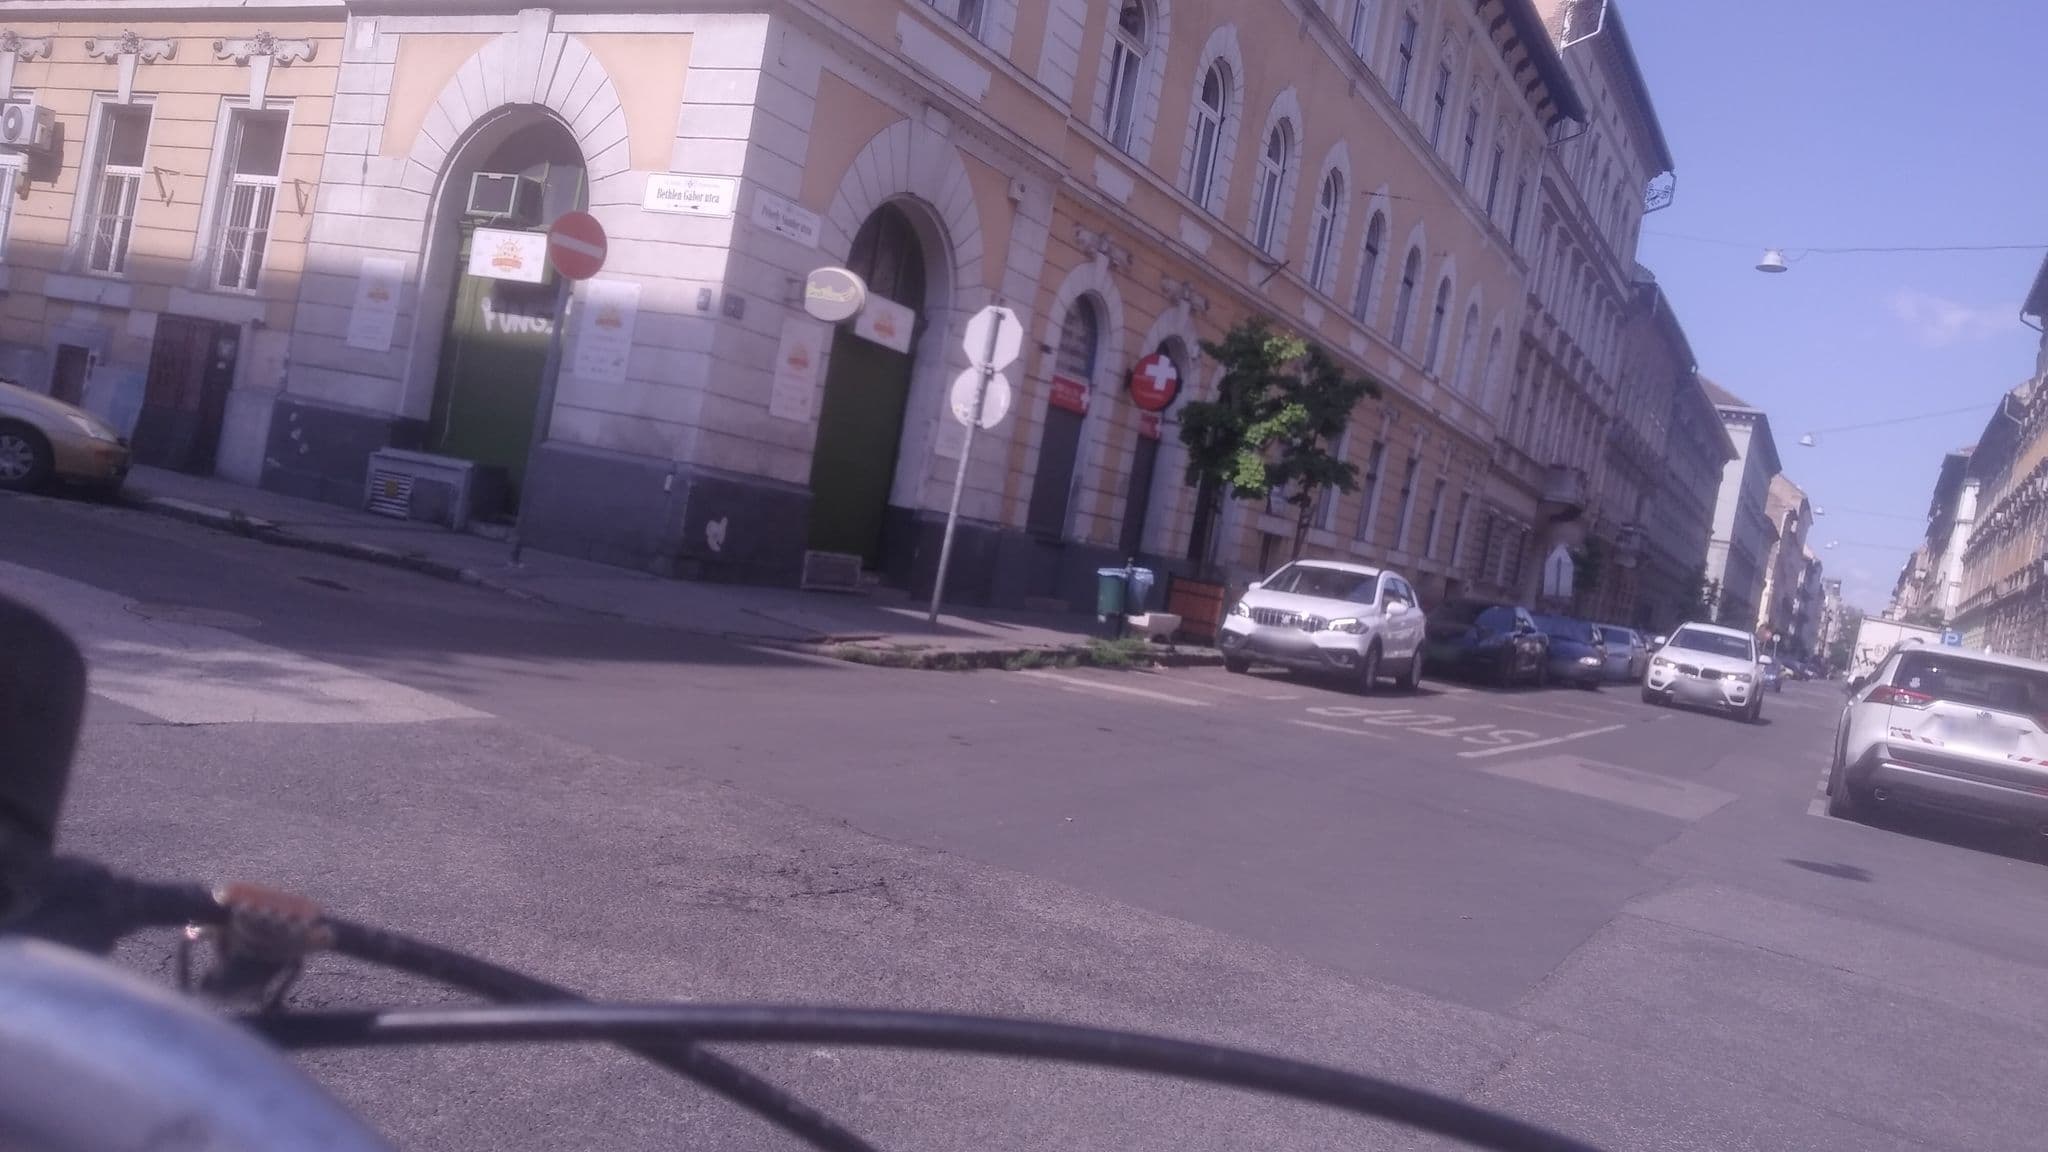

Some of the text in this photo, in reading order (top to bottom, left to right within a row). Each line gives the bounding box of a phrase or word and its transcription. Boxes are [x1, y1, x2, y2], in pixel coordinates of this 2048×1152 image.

[656, 187, 682, 201] Bethlen
[704, 192, 720, 204] utca
[1305, 706, 1540, 746] STOP
